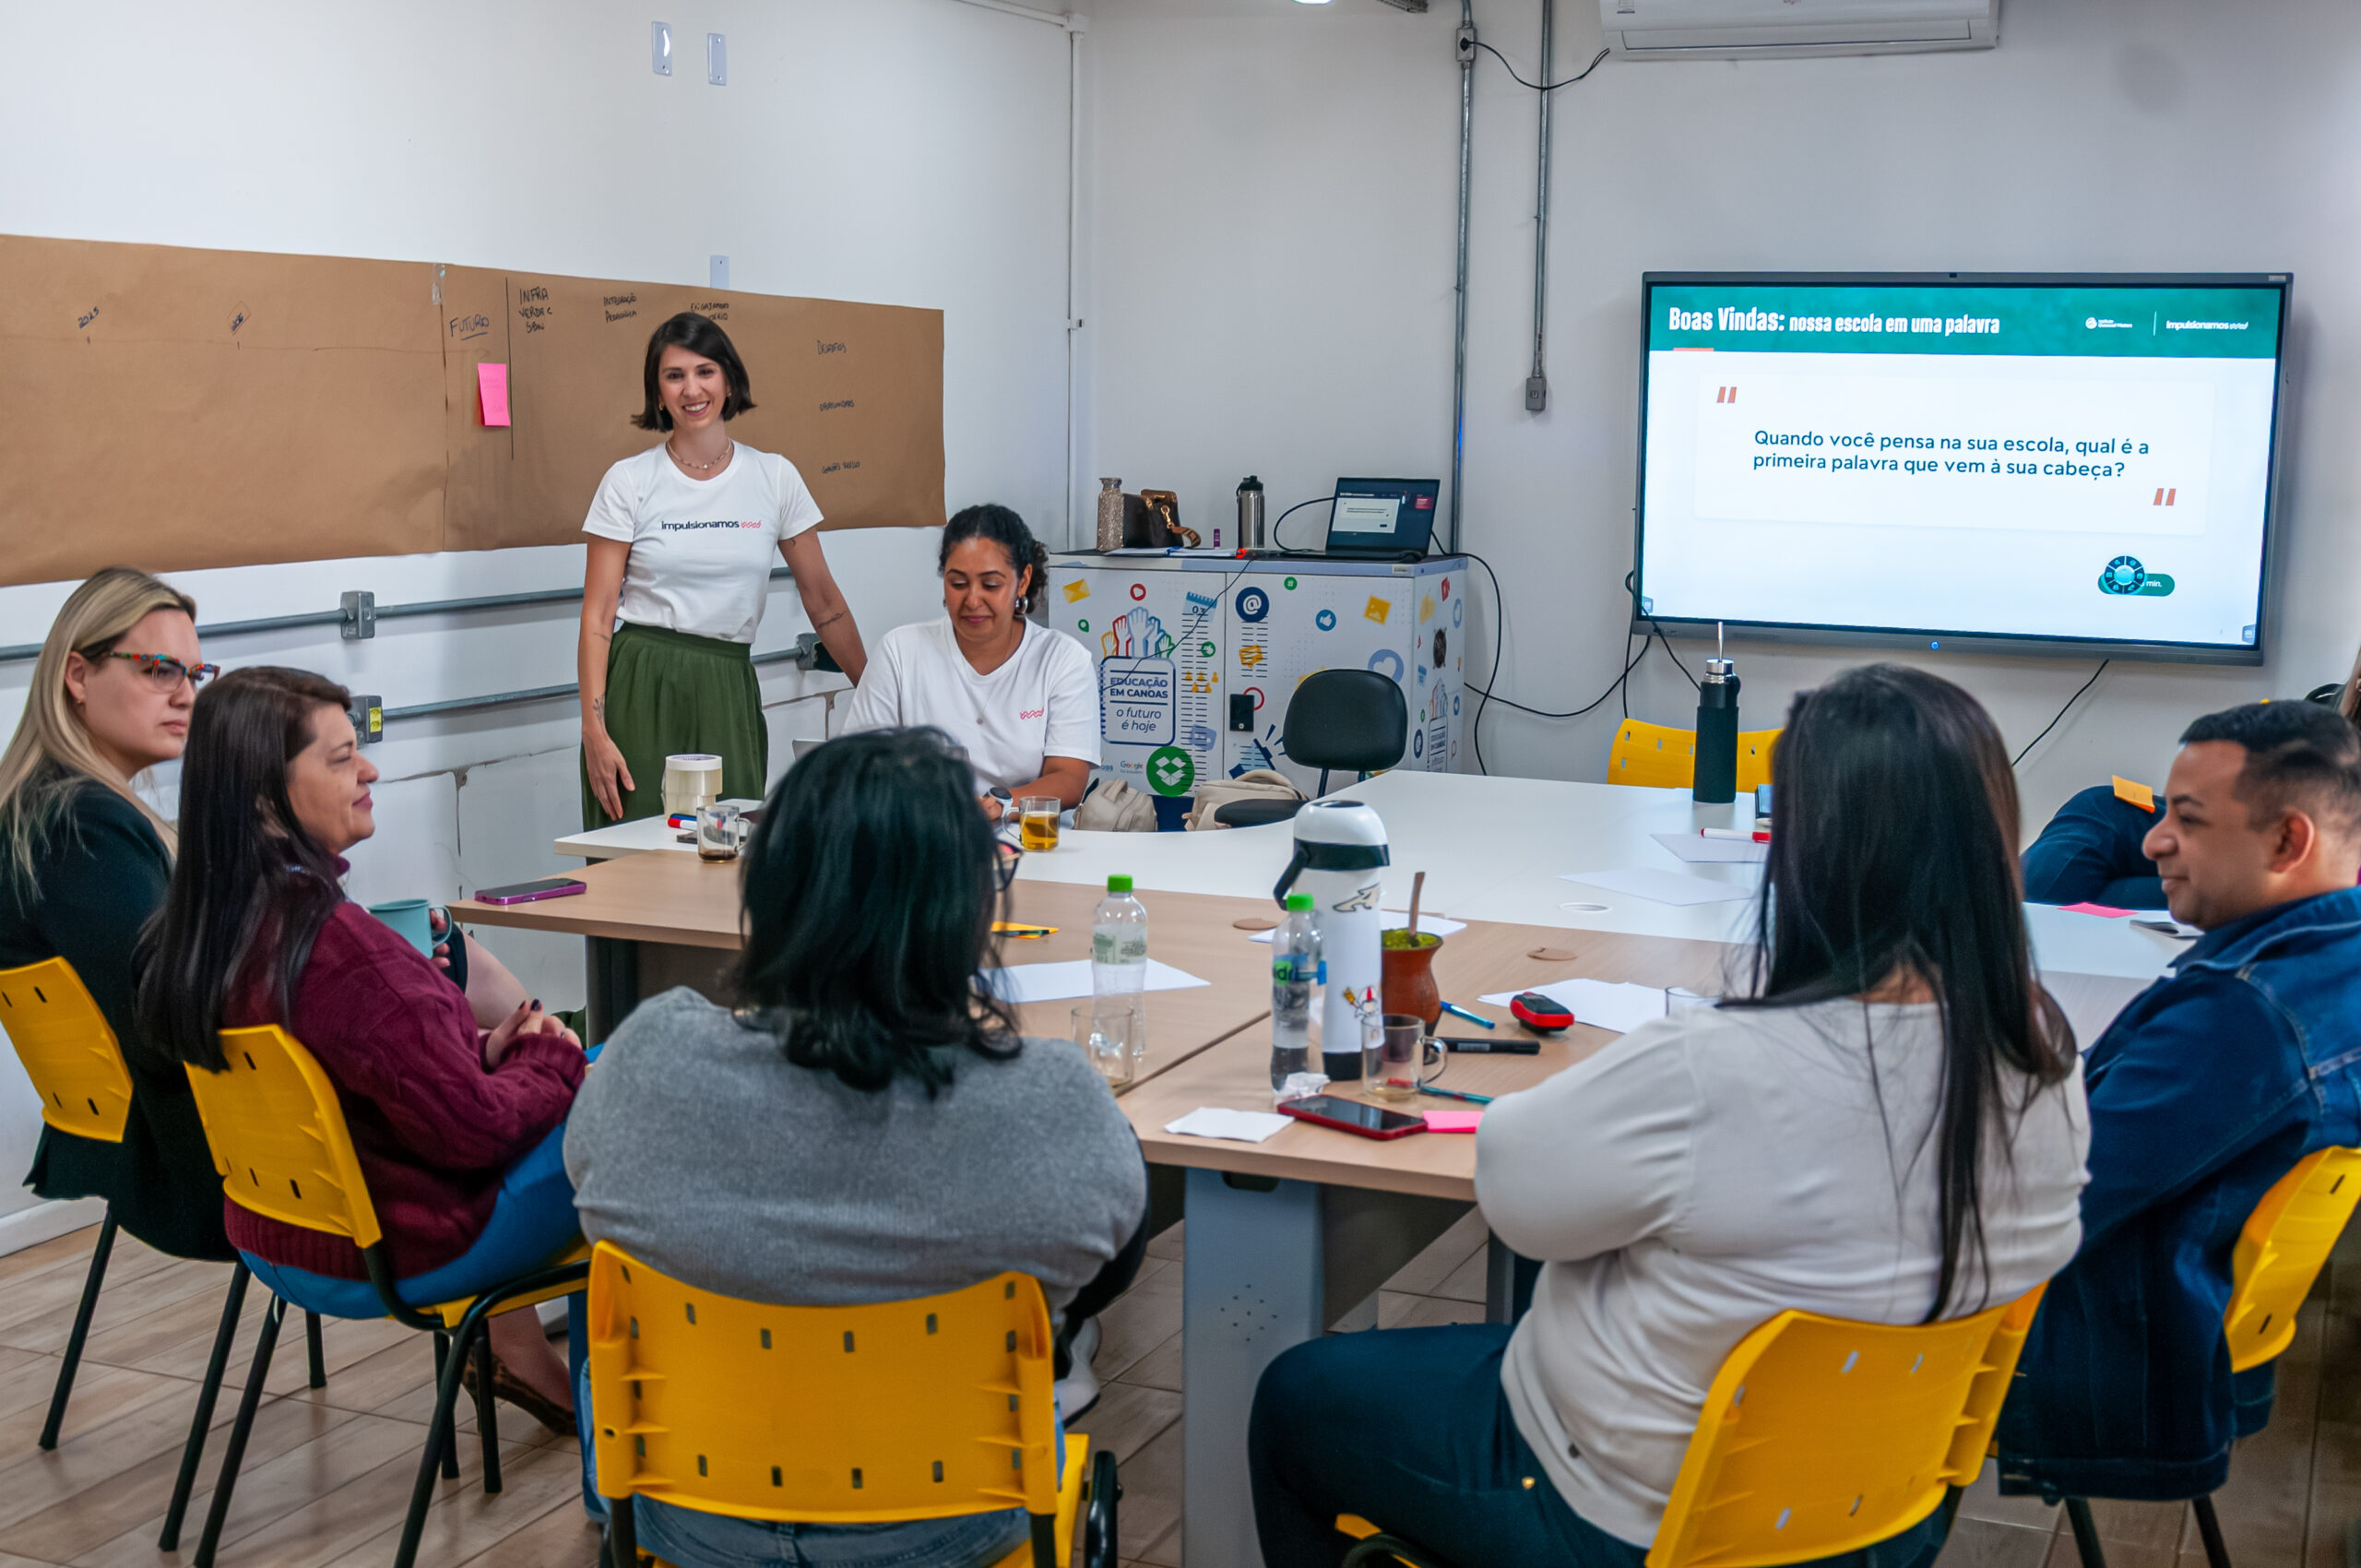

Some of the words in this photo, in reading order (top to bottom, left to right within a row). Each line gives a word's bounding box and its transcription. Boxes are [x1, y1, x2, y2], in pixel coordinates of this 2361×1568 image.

[519, 286, 549, 304] INFRA
[449, 314, 490, 338] FUTURO
[1668, 307, 1714, 330] Boas
[1717, 306, 1786, 331] Vindas:
[1789, 316, 1832, 332] nossa
[1834, 313, 1882, 332] escola
[1885, 317, 1907, 332] em
[1911, 317, 1941, 333] uma
[1944, 314, 1999, 337] palavra
[1754, 430, 1824, 446] Quando
[1830, 432, 1875, 447] você
[1880, 435, 1935, 451] pensa
[1940, 437, 1961, 450] na
[1967, 438, 1998, 450] sua
[2003, 436, 2070, 456] escola,
[2075, 438, 2116, 457] qual
[2121, 438, 2132, 454] é
[2138, 442, 2149, 454] a
[1753, 453, 1826, 470] primeira
[1832, 455, 1898, 472] palavra
[1904, 460, 1938, 475] que
[1944, 461, 1985, 472] vem
[1990, 458, 2000, 473] à
[2007, 462, 2037, 474] sua
[2044, 460, 2125, 481] cabeça?
[661, 520, 740, 531] impulsionamos
[1110, 676, 1169, 689] EDUCAÇÃO
[1110, 688, 1125, 696] EM
[1127, 688, 1169, 699] CANOAS
[1116, 709, 1123, 718] o
[1126, 707, 1162, 719] futuro
[1121, 719, 1129, 731] é
[1131, 719, 1157, 733] hoje
